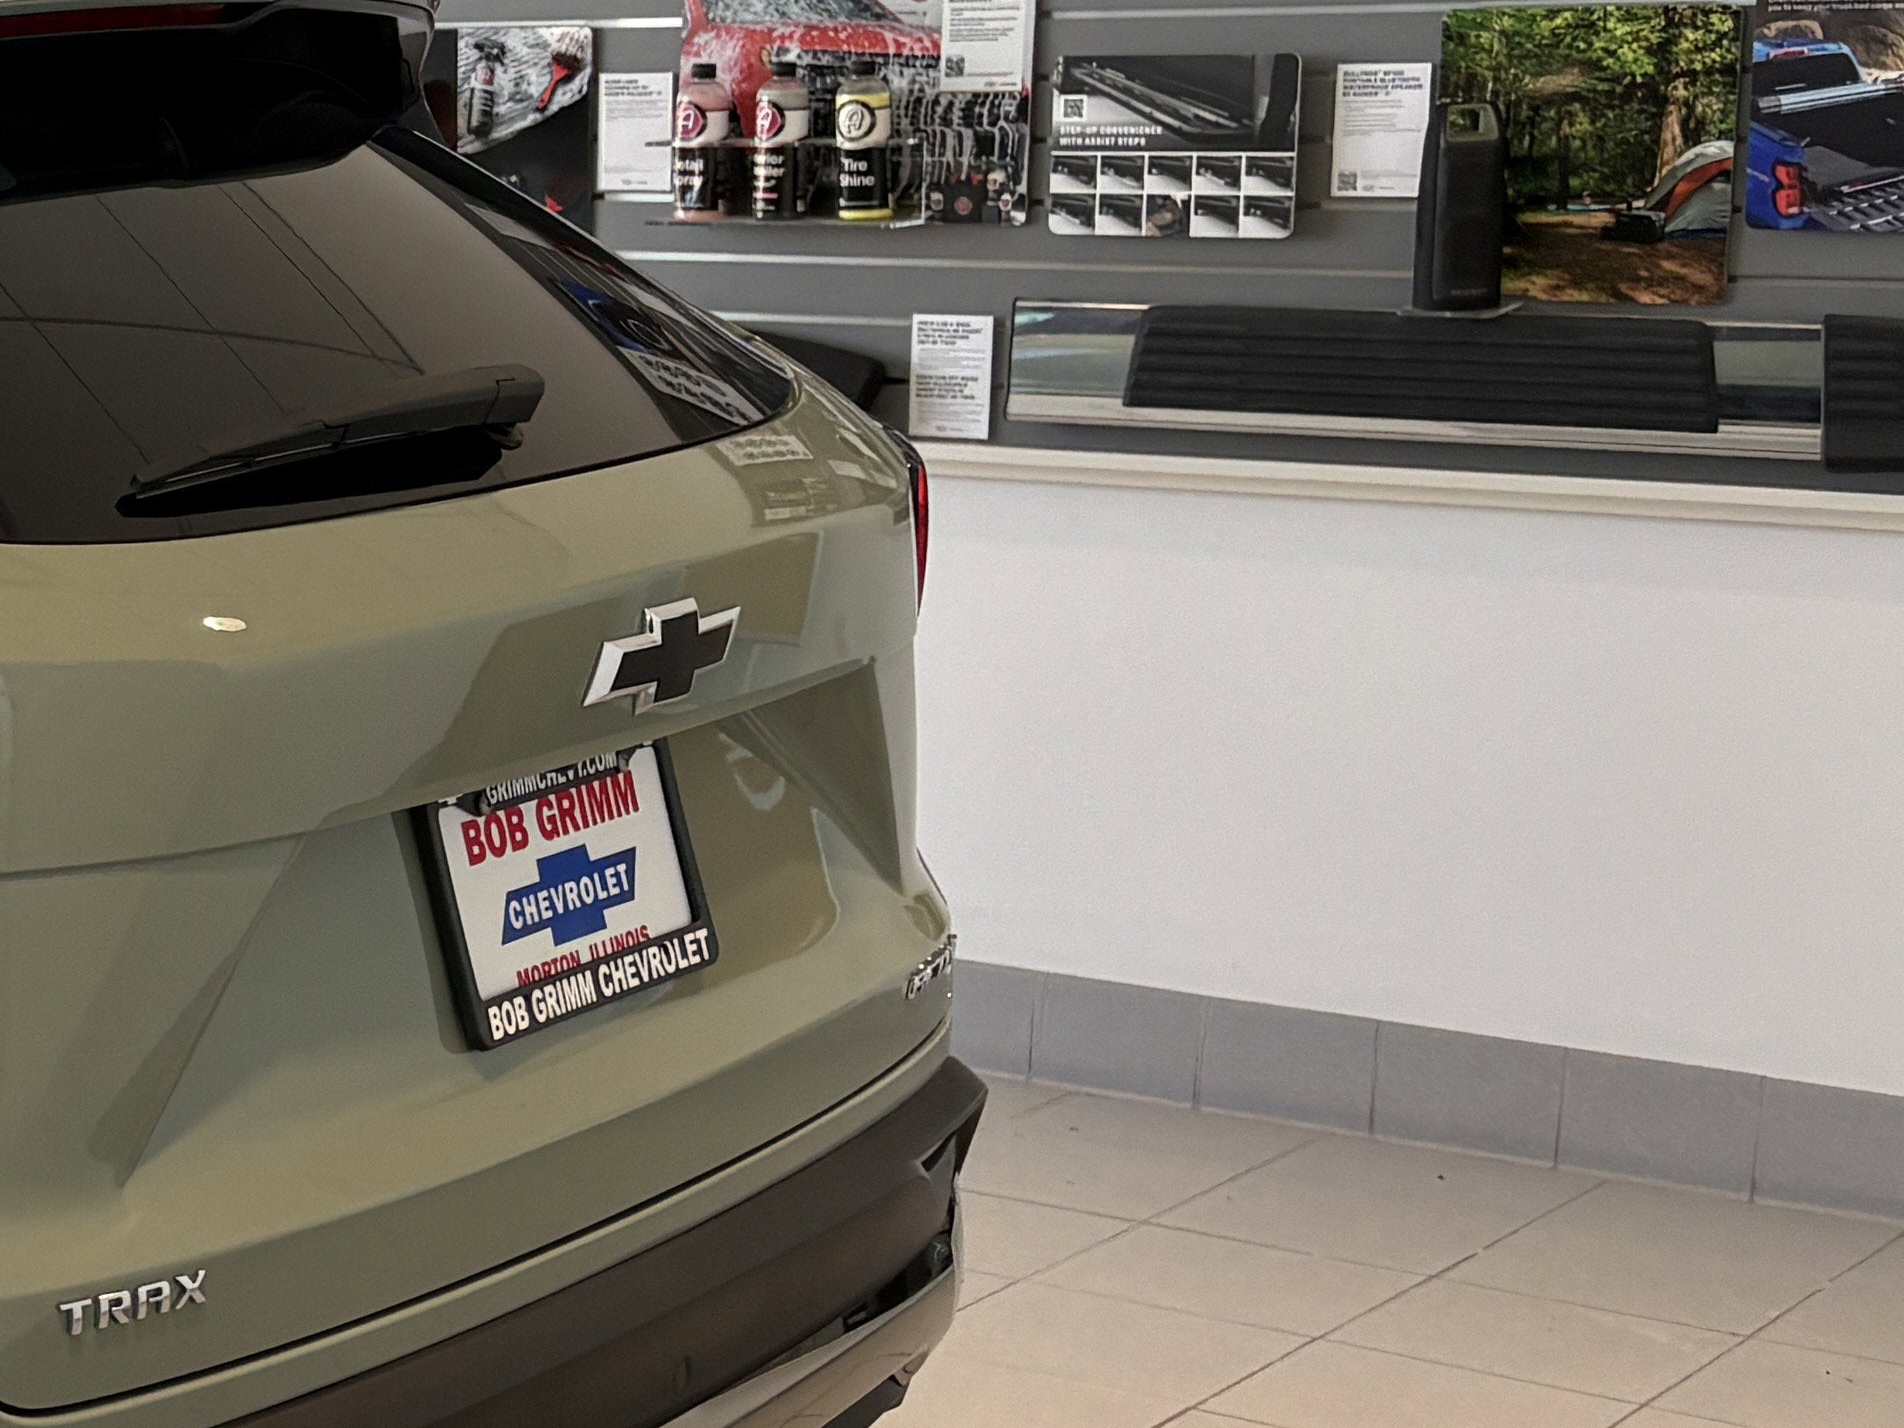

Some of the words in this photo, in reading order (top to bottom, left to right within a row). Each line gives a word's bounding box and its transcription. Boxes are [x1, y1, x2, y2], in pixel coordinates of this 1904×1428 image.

[839, 173, 875, 188] Shine
[840, 157, 868, 172] Tire
[460, 805, 529, 867] BOB
[535, 770, 640, 841] GRIMM
[508, 863, 630, 930] CHEVROLET
[487, 995, 529, 1041] BOB
[530, 970, 597, 1023] GRIMM
[597, 927, 711, 998] CHEVROLET
[516, 950, 583, 988] MORTON
[588, 925, 651, 962] ILLINOIS
[58, 1269, 207, 1336] TRAX
